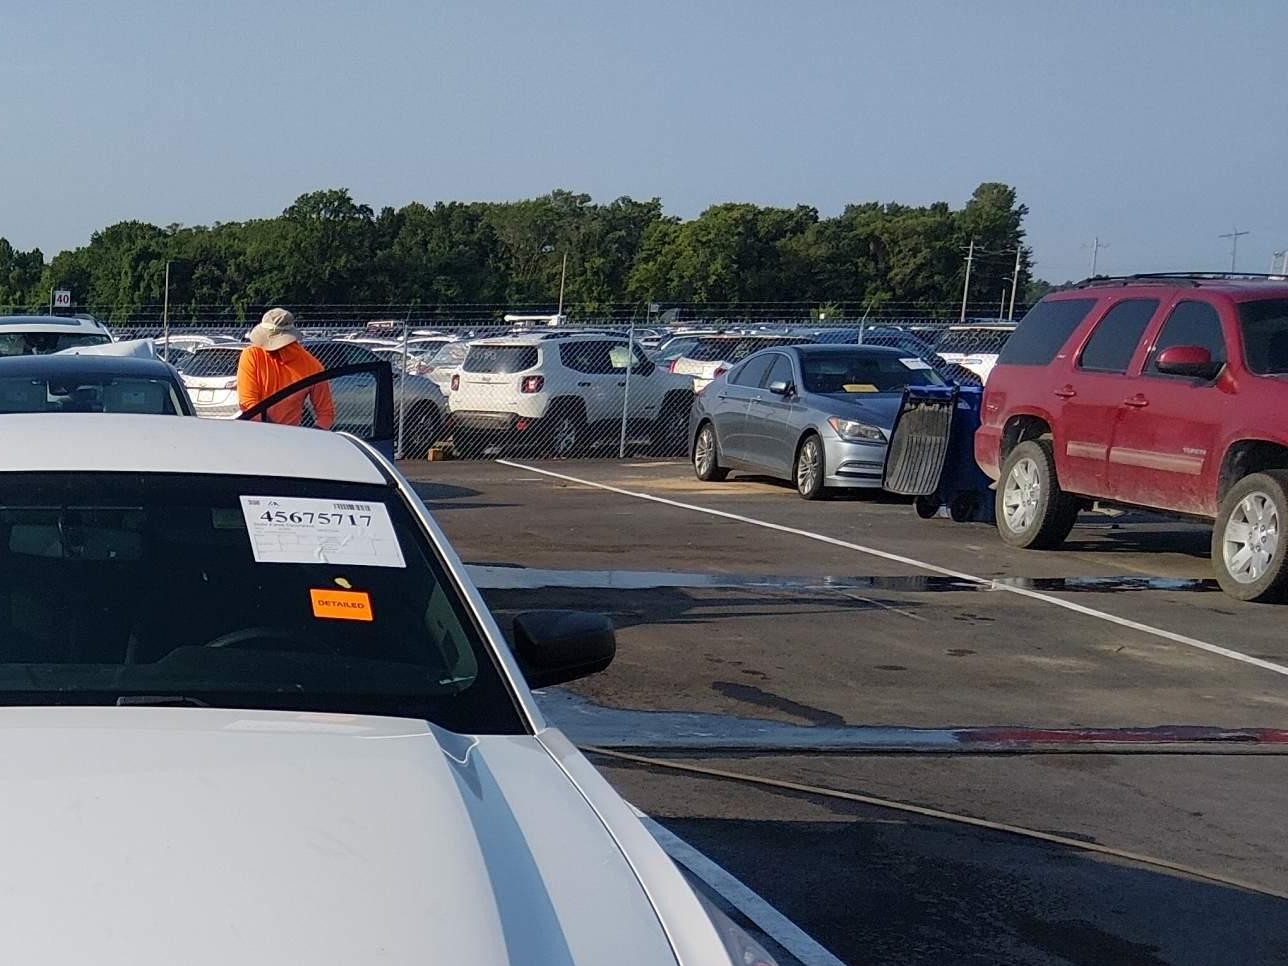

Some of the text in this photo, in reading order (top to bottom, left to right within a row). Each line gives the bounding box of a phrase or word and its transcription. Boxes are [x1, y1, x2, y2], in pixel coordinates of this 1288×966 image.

[56, 294, 69, 304] 40
[260, 510, 372, 527] 45675717
[317, 599, 365, 609] DETAILED
